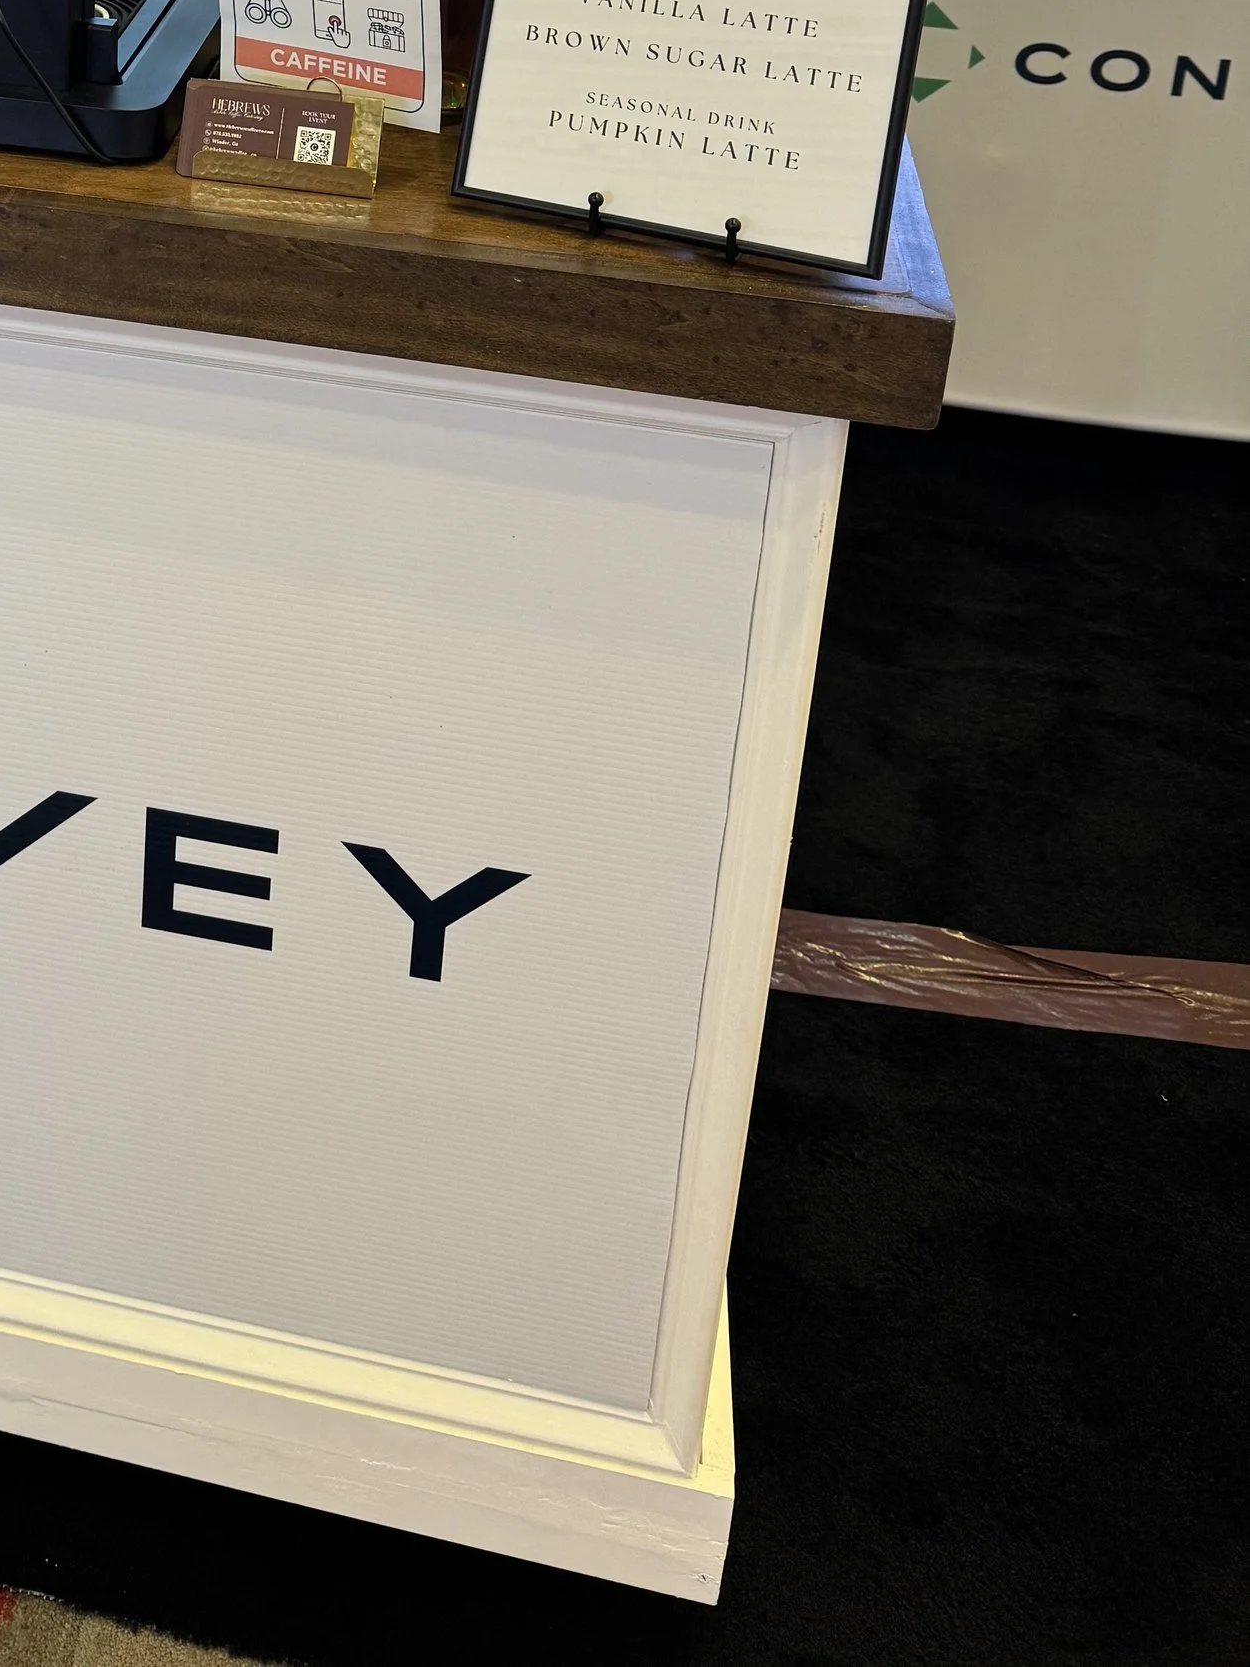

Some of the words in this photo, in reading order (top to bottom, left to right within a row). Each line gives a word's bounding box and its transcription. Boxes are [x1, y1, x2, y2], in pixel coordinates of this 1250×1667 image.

[722, 7, 819, 38] LATTE
[270, 48, 387, 86] CAFFEINE
[526, 24, 631, 56] BROWN
[646, 43, 747, 75] SUGAR
[764, 61, 862, 93] LATTE
[1015, 42, 1232, 101] CON
[212, 98, 271, 116] HEBREWS
[586, 91, 697, 122] SEASONAL
[708, 111, 775, 135] DRINK
[549, 110, 685, 150] PUMPKIN
[702, 136, 801, 171] LATTE
